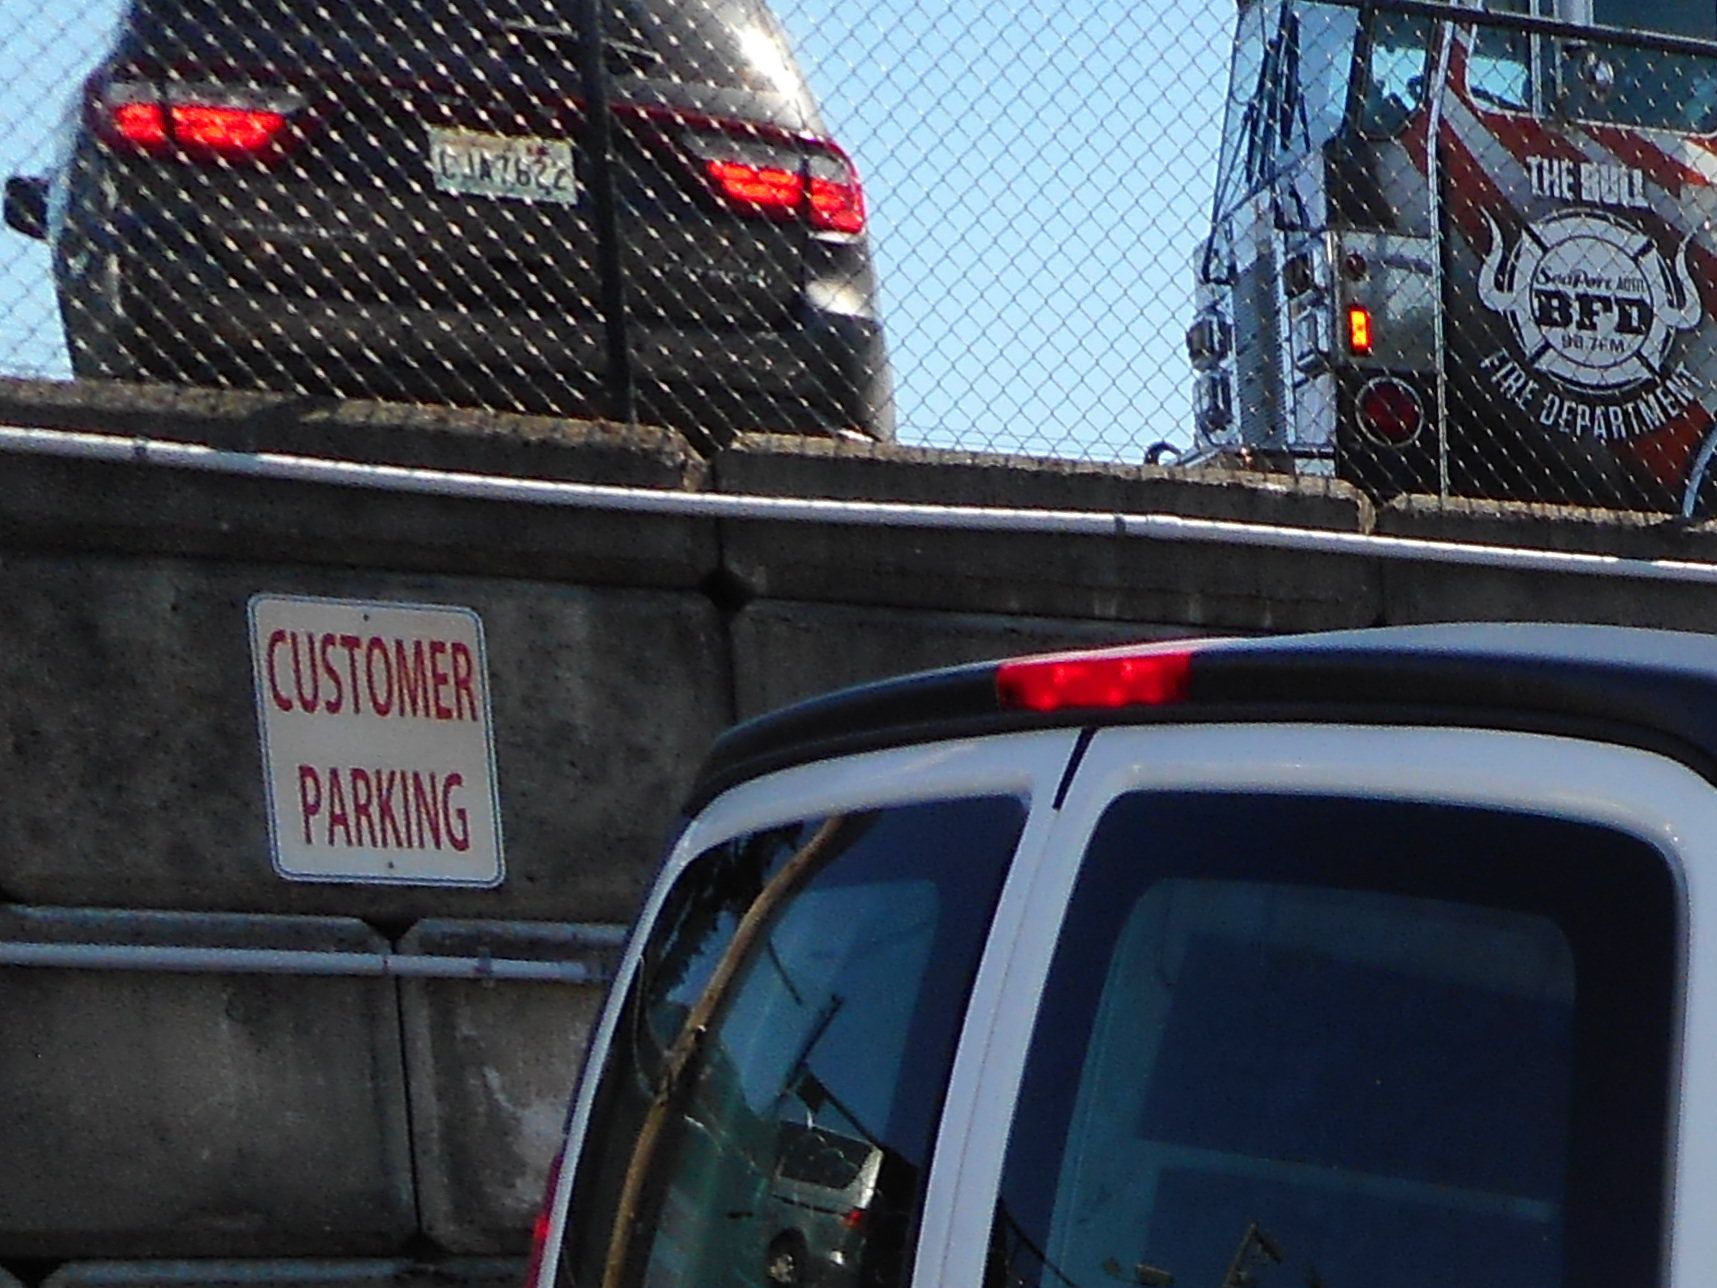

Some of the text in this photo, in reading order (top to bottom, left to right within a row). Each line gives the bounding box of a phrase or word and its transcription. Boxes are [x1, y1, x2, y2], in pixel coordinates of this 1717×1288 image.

[1526, 155, 1651, 207] THE BULL
[1532, 288, 1651, 335] BFD
[1480, 352, 1704, 441] FIRE DEPARTMENT
[267, 629, 478, 722] CUSTOMER
[298, 764, 470, 852] PARKING
